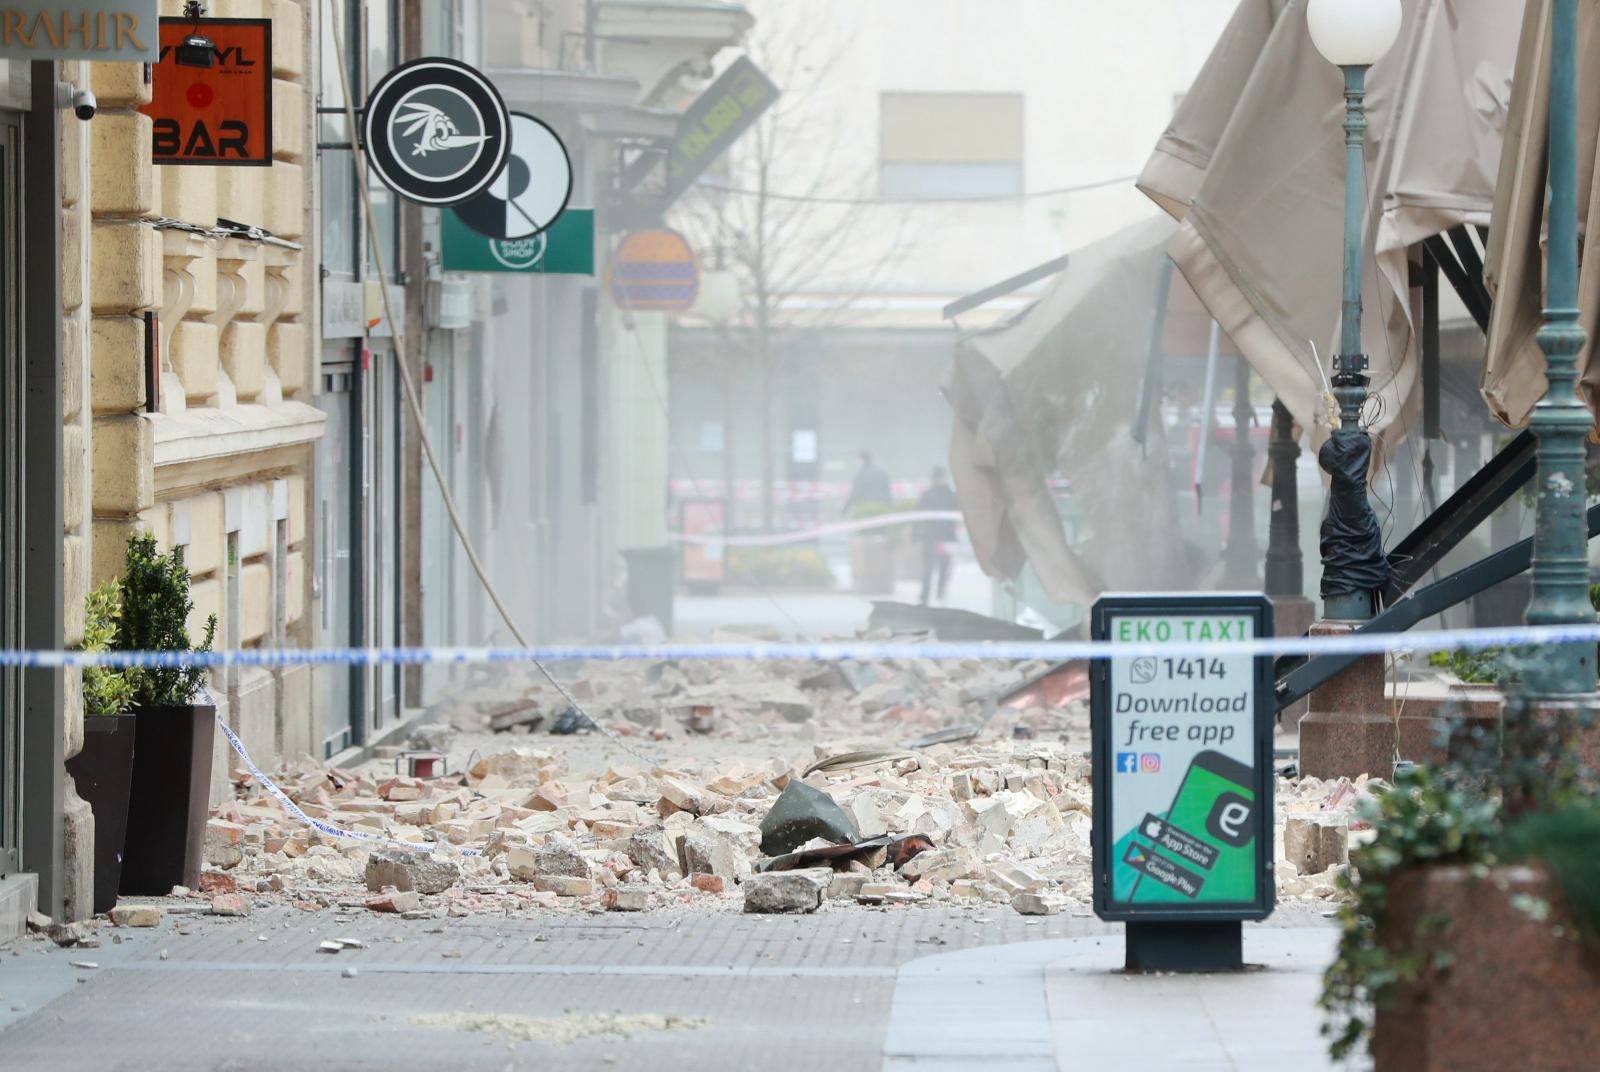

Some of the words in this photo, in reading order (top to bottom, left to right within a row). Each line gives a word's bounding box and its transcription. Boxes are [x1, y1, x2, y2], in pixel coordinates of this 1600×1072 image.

[152, 118, 250, 157] BAR
[1119, 620, 1171, 642] EKO
[1182, 620, 1247, 642] TAXI
[1163, 658, 1226, 680] 1414
[1116, 692, 1247, 714] Download
[1125, 720, 1180, 746] free
[1187, 724, 1235, 746] app
[1161, 833, 1183, 852] App
[1182, 843, 1209, 866] Store
[1146, 861, 1178, 884] Google
[1177, 876, 1197, 895] Play
